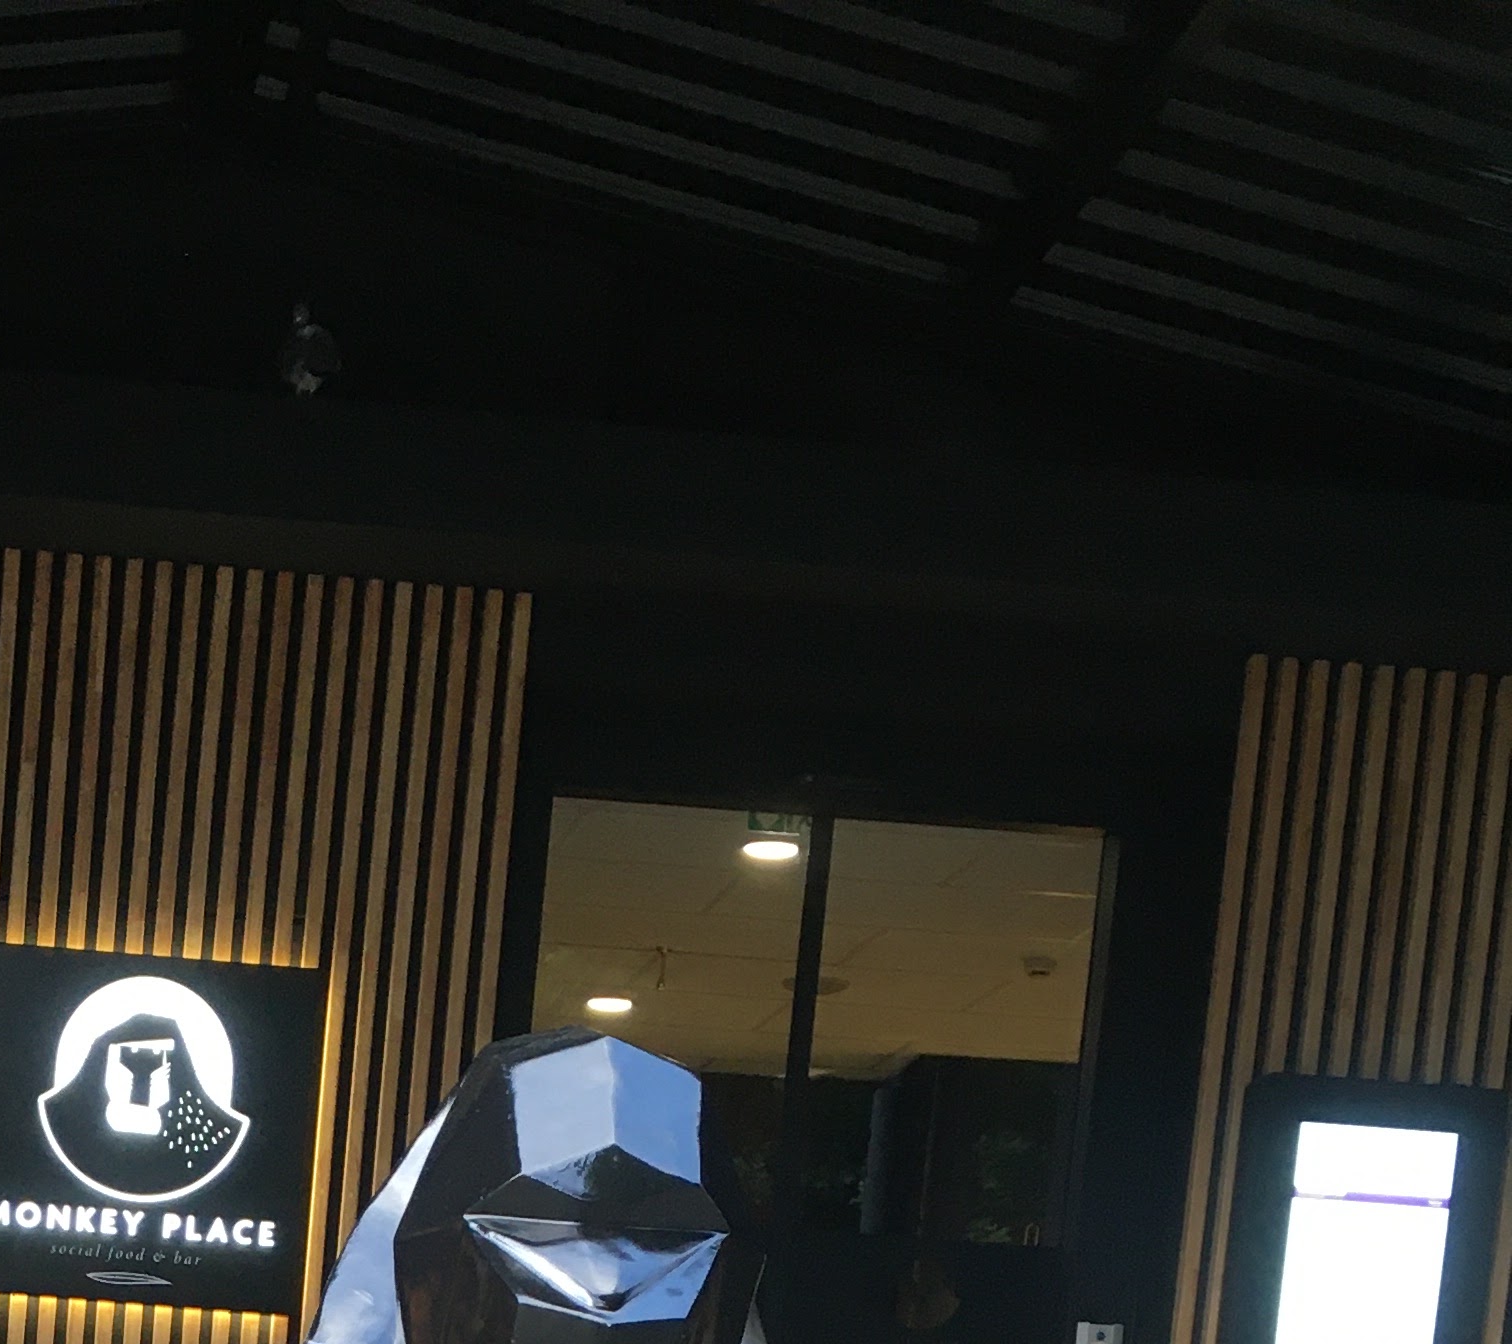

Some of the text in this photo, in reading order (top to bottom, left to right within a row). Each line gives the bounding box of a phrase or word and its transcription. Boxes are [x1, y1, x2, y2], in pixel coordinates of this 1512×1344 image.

[160, 1211, 277, 1248] PLACE
[49, 1243, 203, 1266] social food & bar
